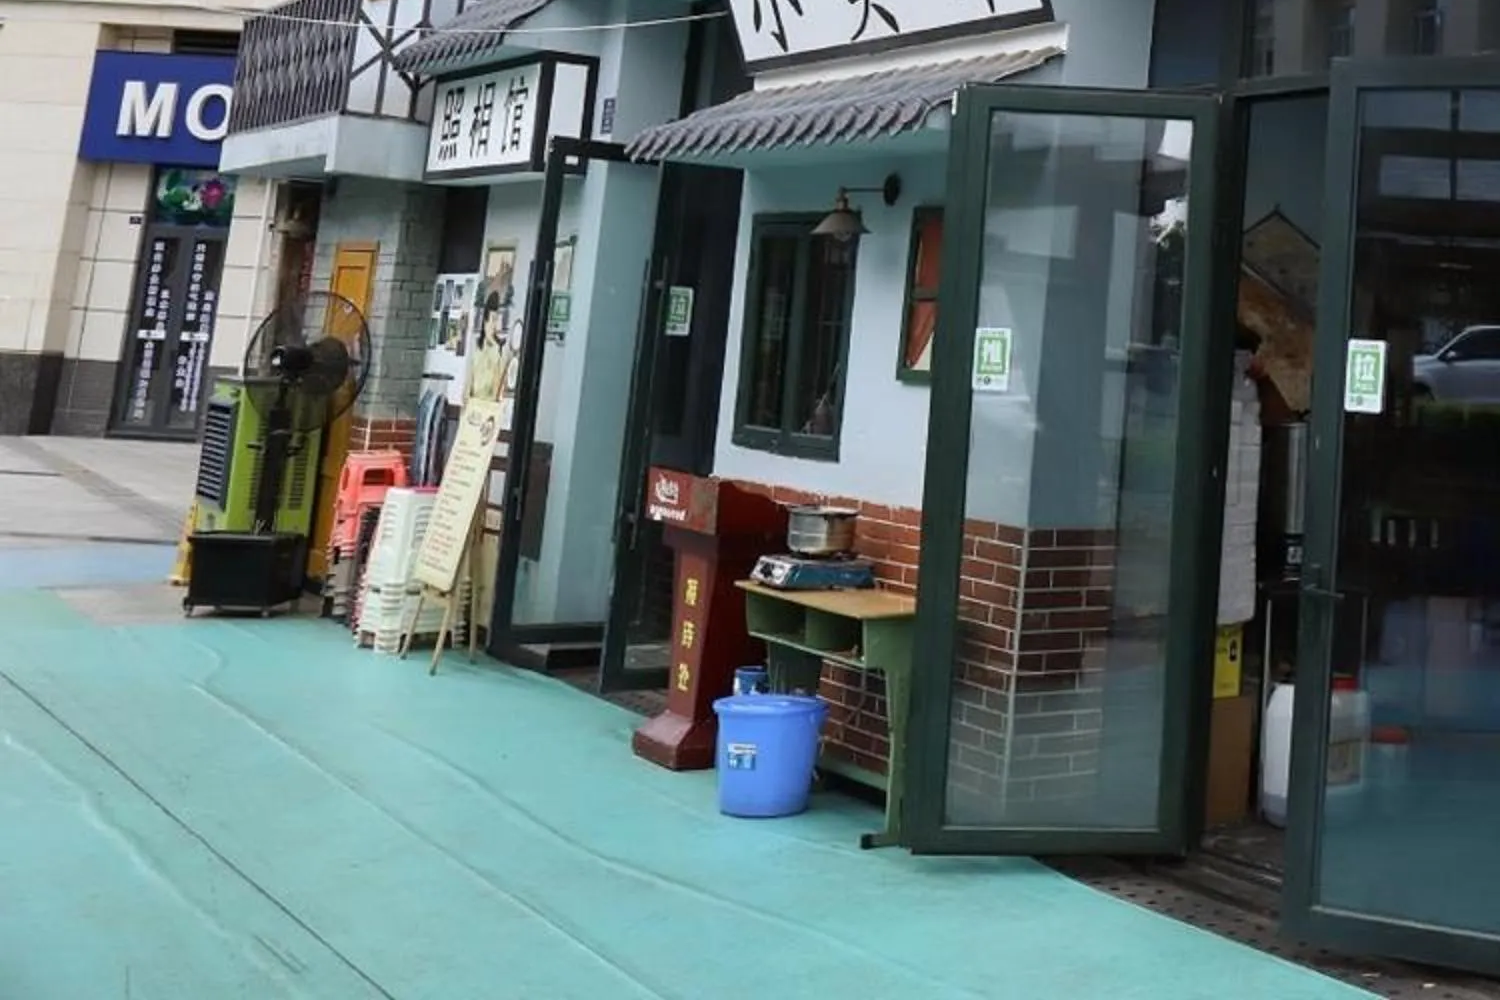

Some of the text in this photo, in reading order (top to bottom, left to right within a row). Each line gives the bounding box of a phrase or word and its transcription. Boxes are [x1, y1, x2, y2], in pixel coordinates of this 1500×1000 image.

[116, 80, 233, 140] MO
[438, 75, 529, 161] 照相馆
